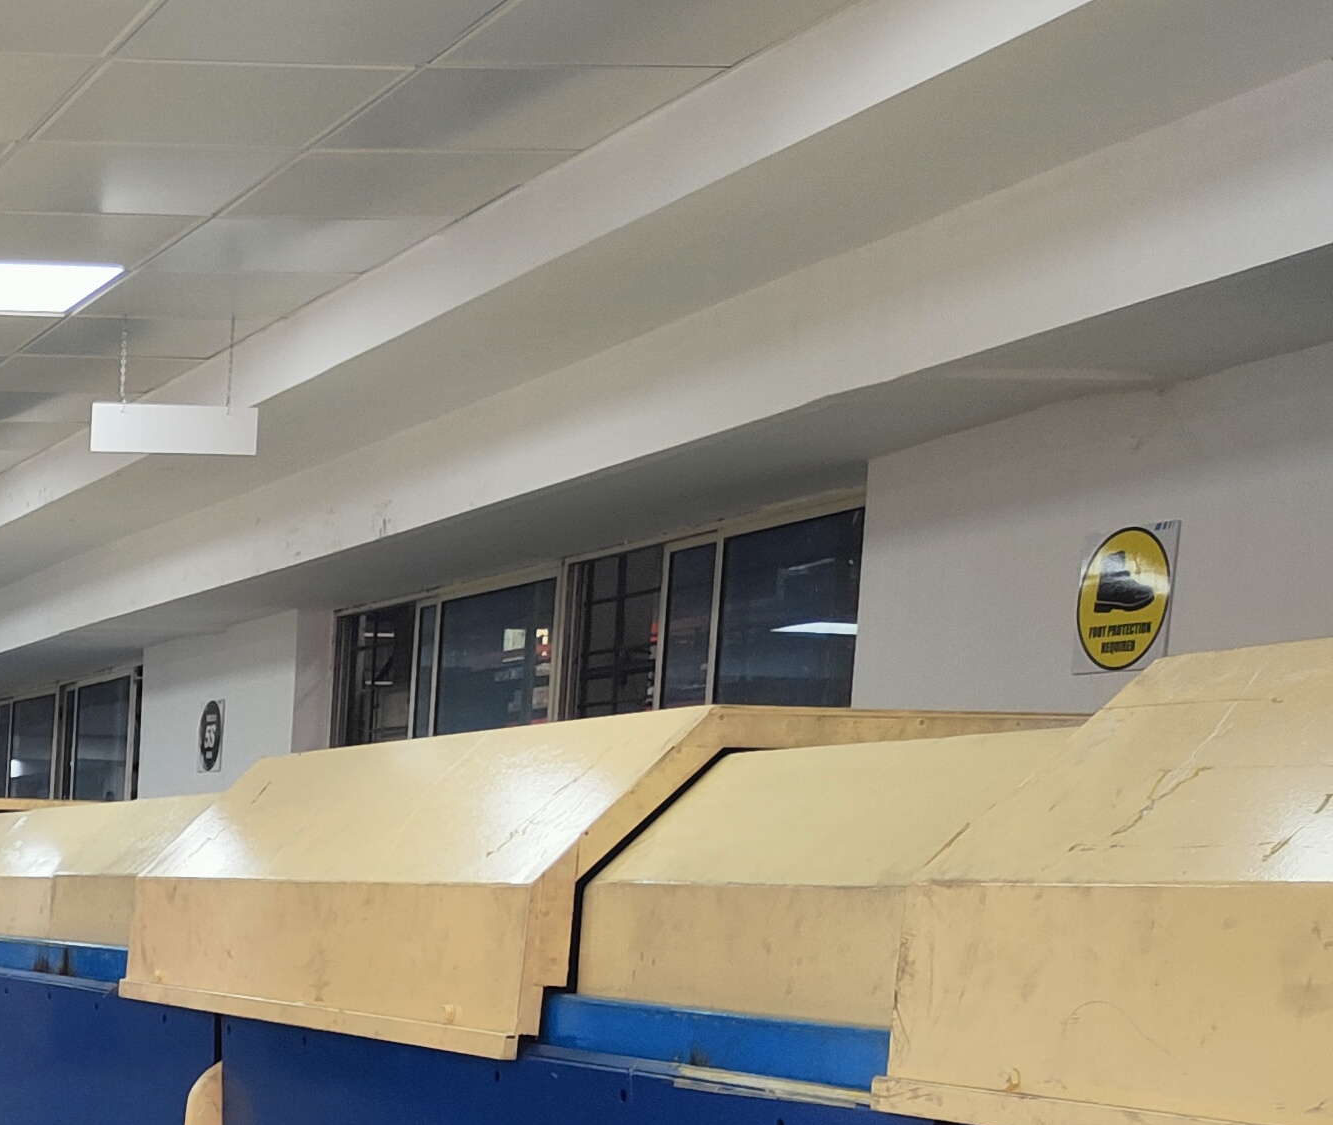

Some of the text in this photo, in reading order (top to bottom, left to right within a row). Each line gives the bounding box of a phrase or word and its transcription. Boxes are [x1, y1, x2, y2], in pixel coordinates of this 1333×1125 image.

[1088, 621, 1152, 639] FOOT PROTECTION
[1101, 640, 1136, 654] REQUIRED
